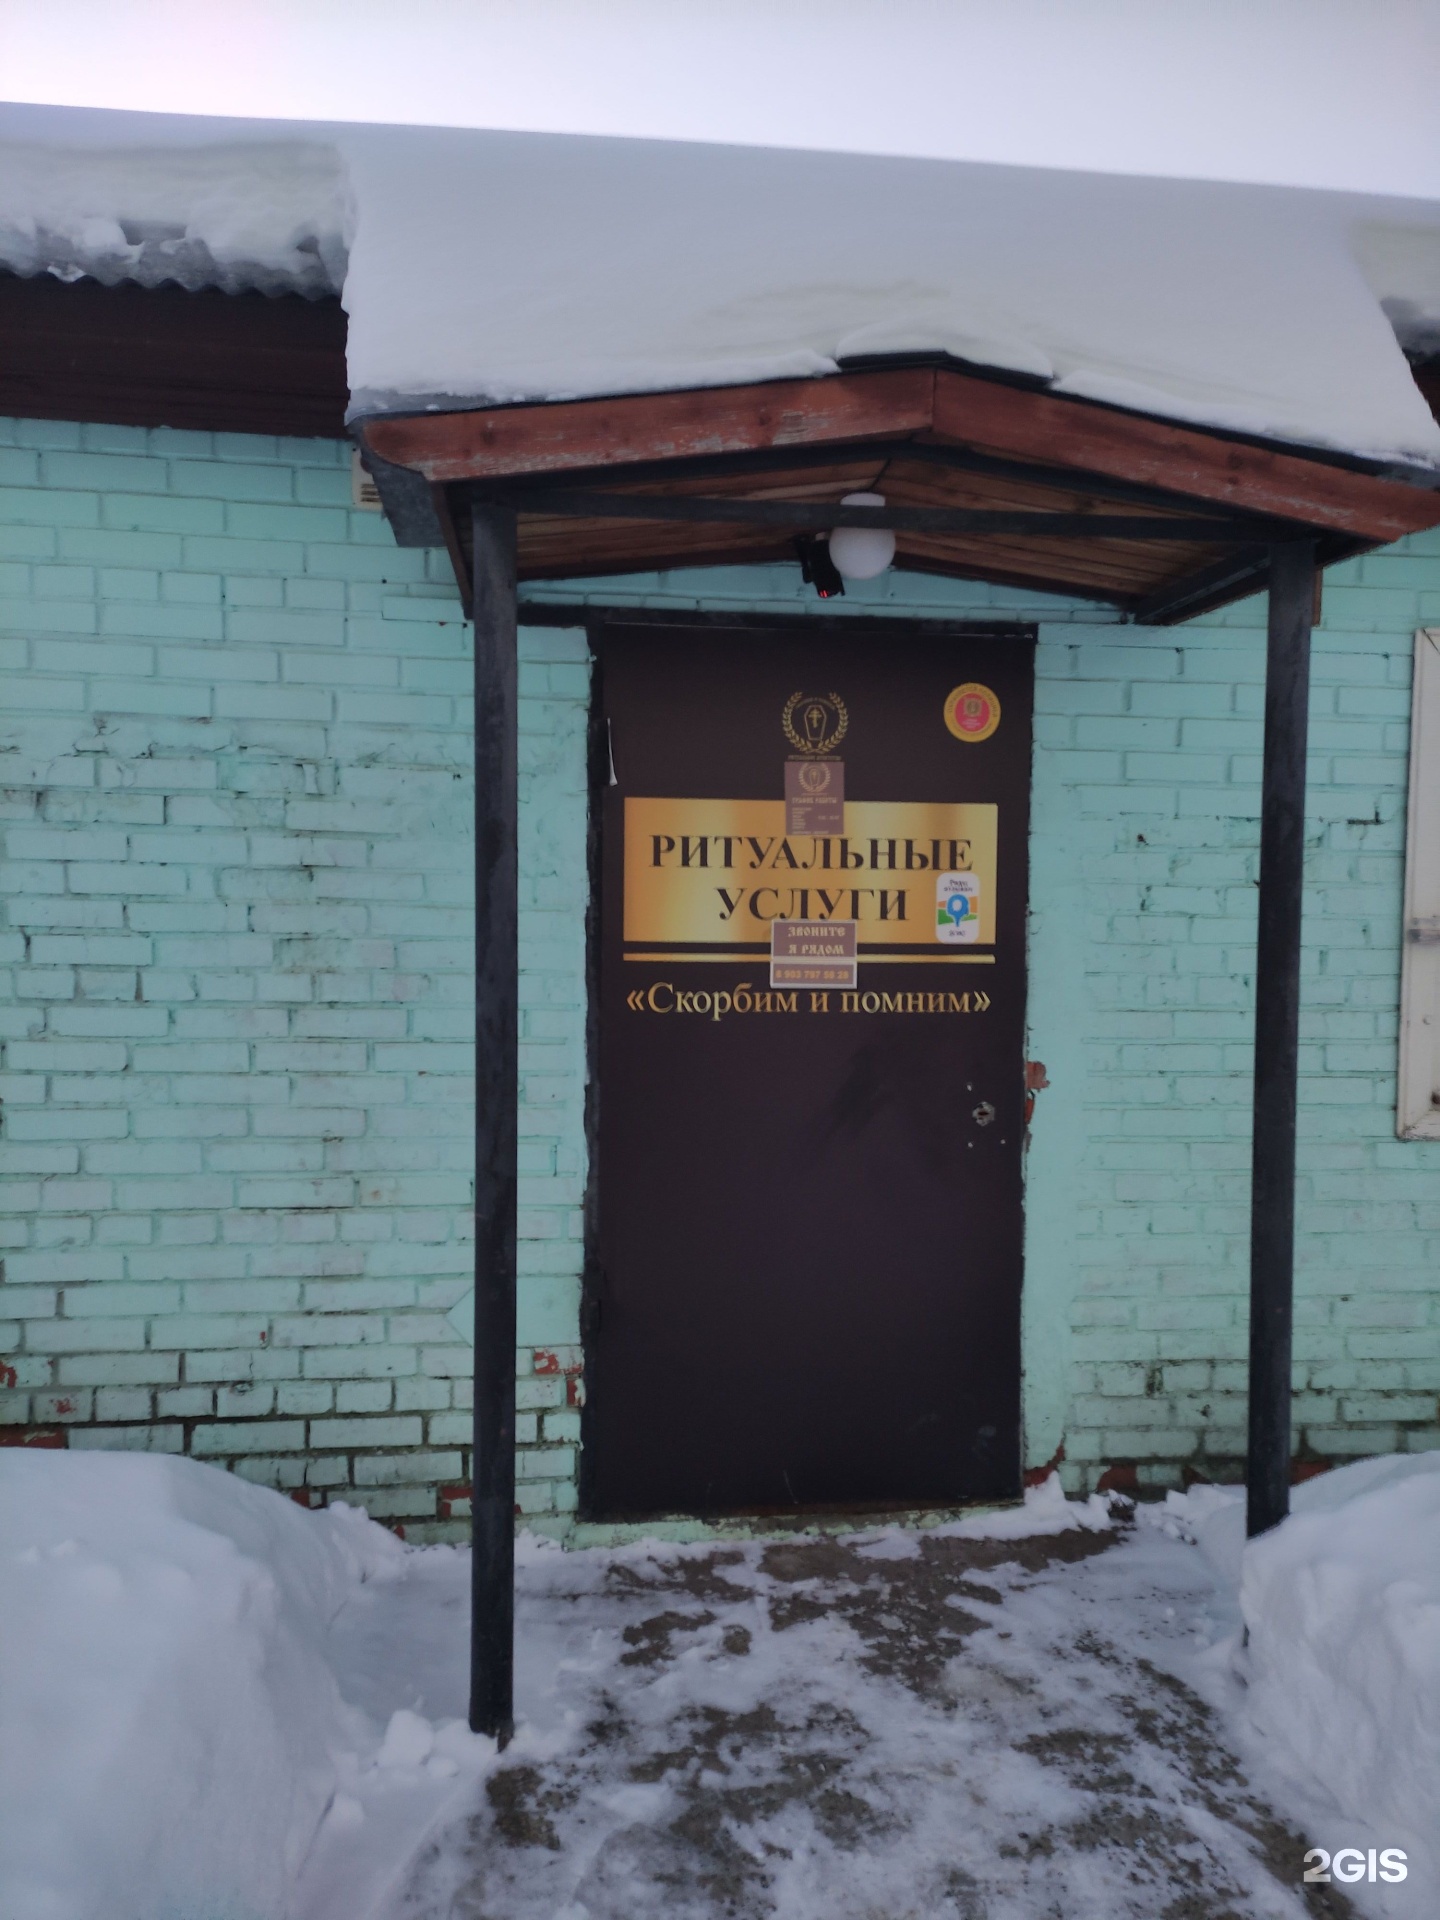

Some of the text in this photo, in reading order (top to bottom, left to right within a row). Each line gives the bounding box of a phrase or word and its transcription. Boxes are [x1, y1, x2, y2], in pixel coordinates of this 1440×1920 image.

[649, 835, 973, 871] РИТУАЛЬНЫЕ
[714, 887, 910, 921] УСЛУГИ
[788, 944, 844, 955] Я РЯДОМ
[627, 982, 991, 1021] «Скорбим и помним»
